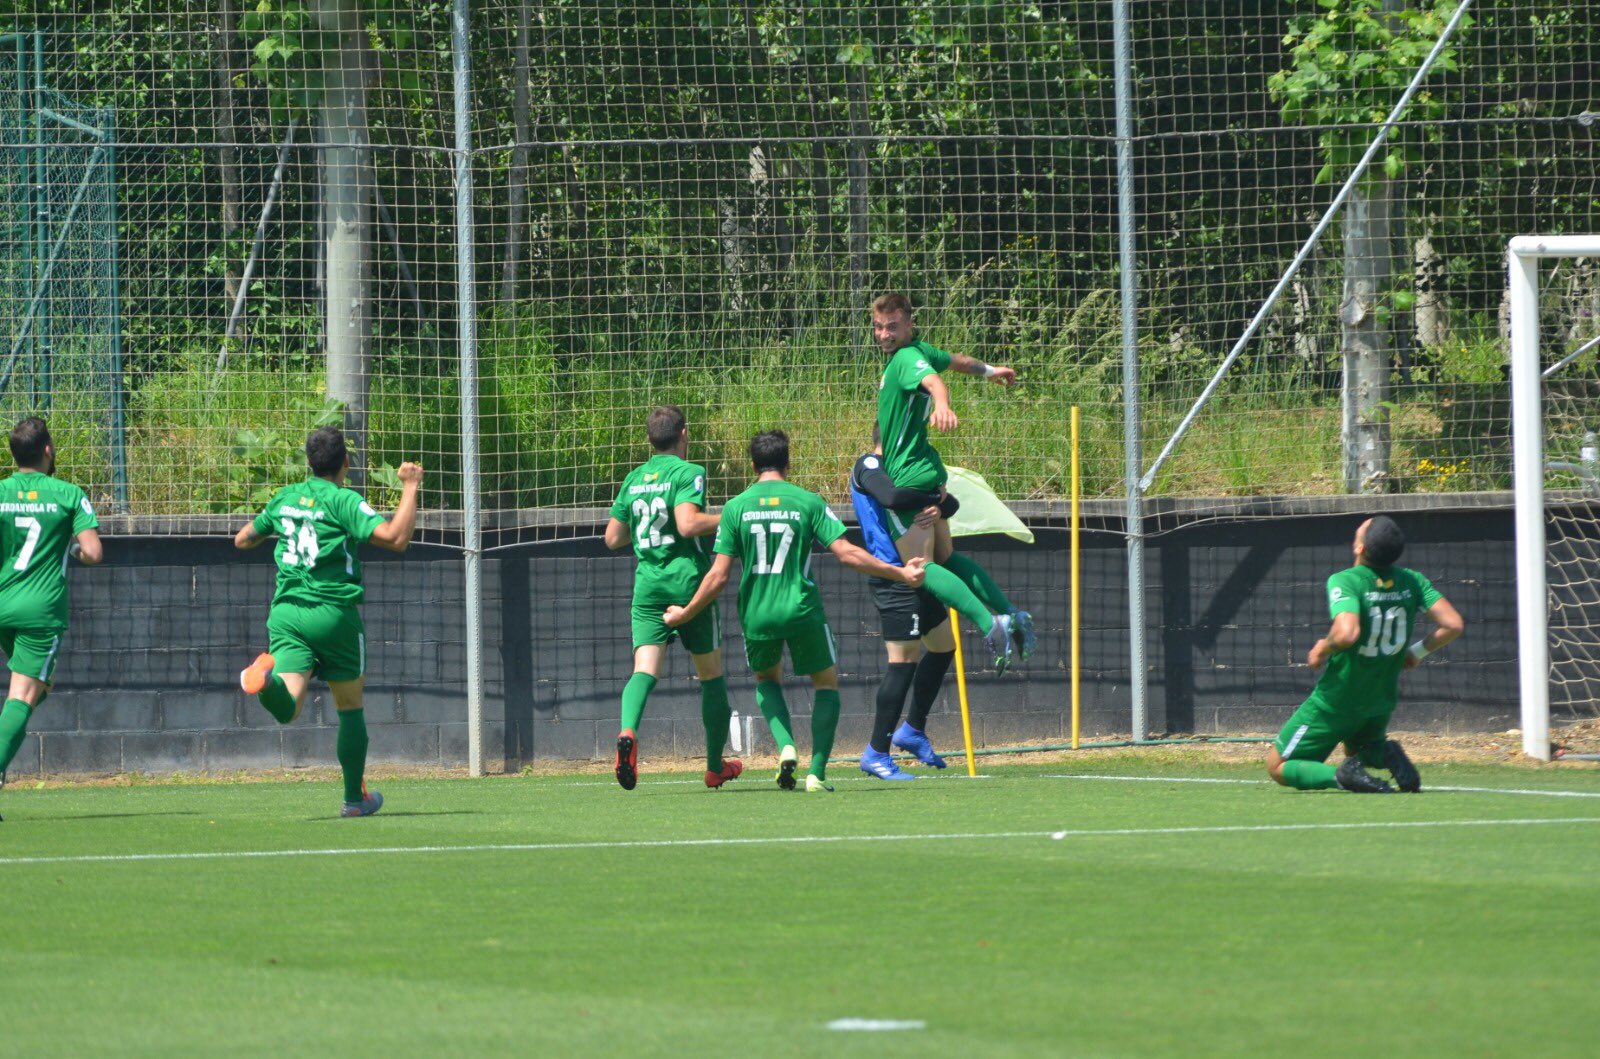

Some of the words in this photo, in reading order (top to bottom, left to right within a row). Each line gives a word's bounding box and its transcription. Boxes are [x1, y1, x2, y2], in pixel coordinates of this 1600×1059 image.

[46, 503, 58, 513] FC
[632, 497, 675, 549] 22
[742, 510, 789, 521] CERDANYOLA
[790, 510, 801, 521] FC
[13, 516, 42, 571] 7
[750, 522, 795, 574] 17
[910, 613, 920, 636] 1
[1358, 606, 1407, 657] 10
